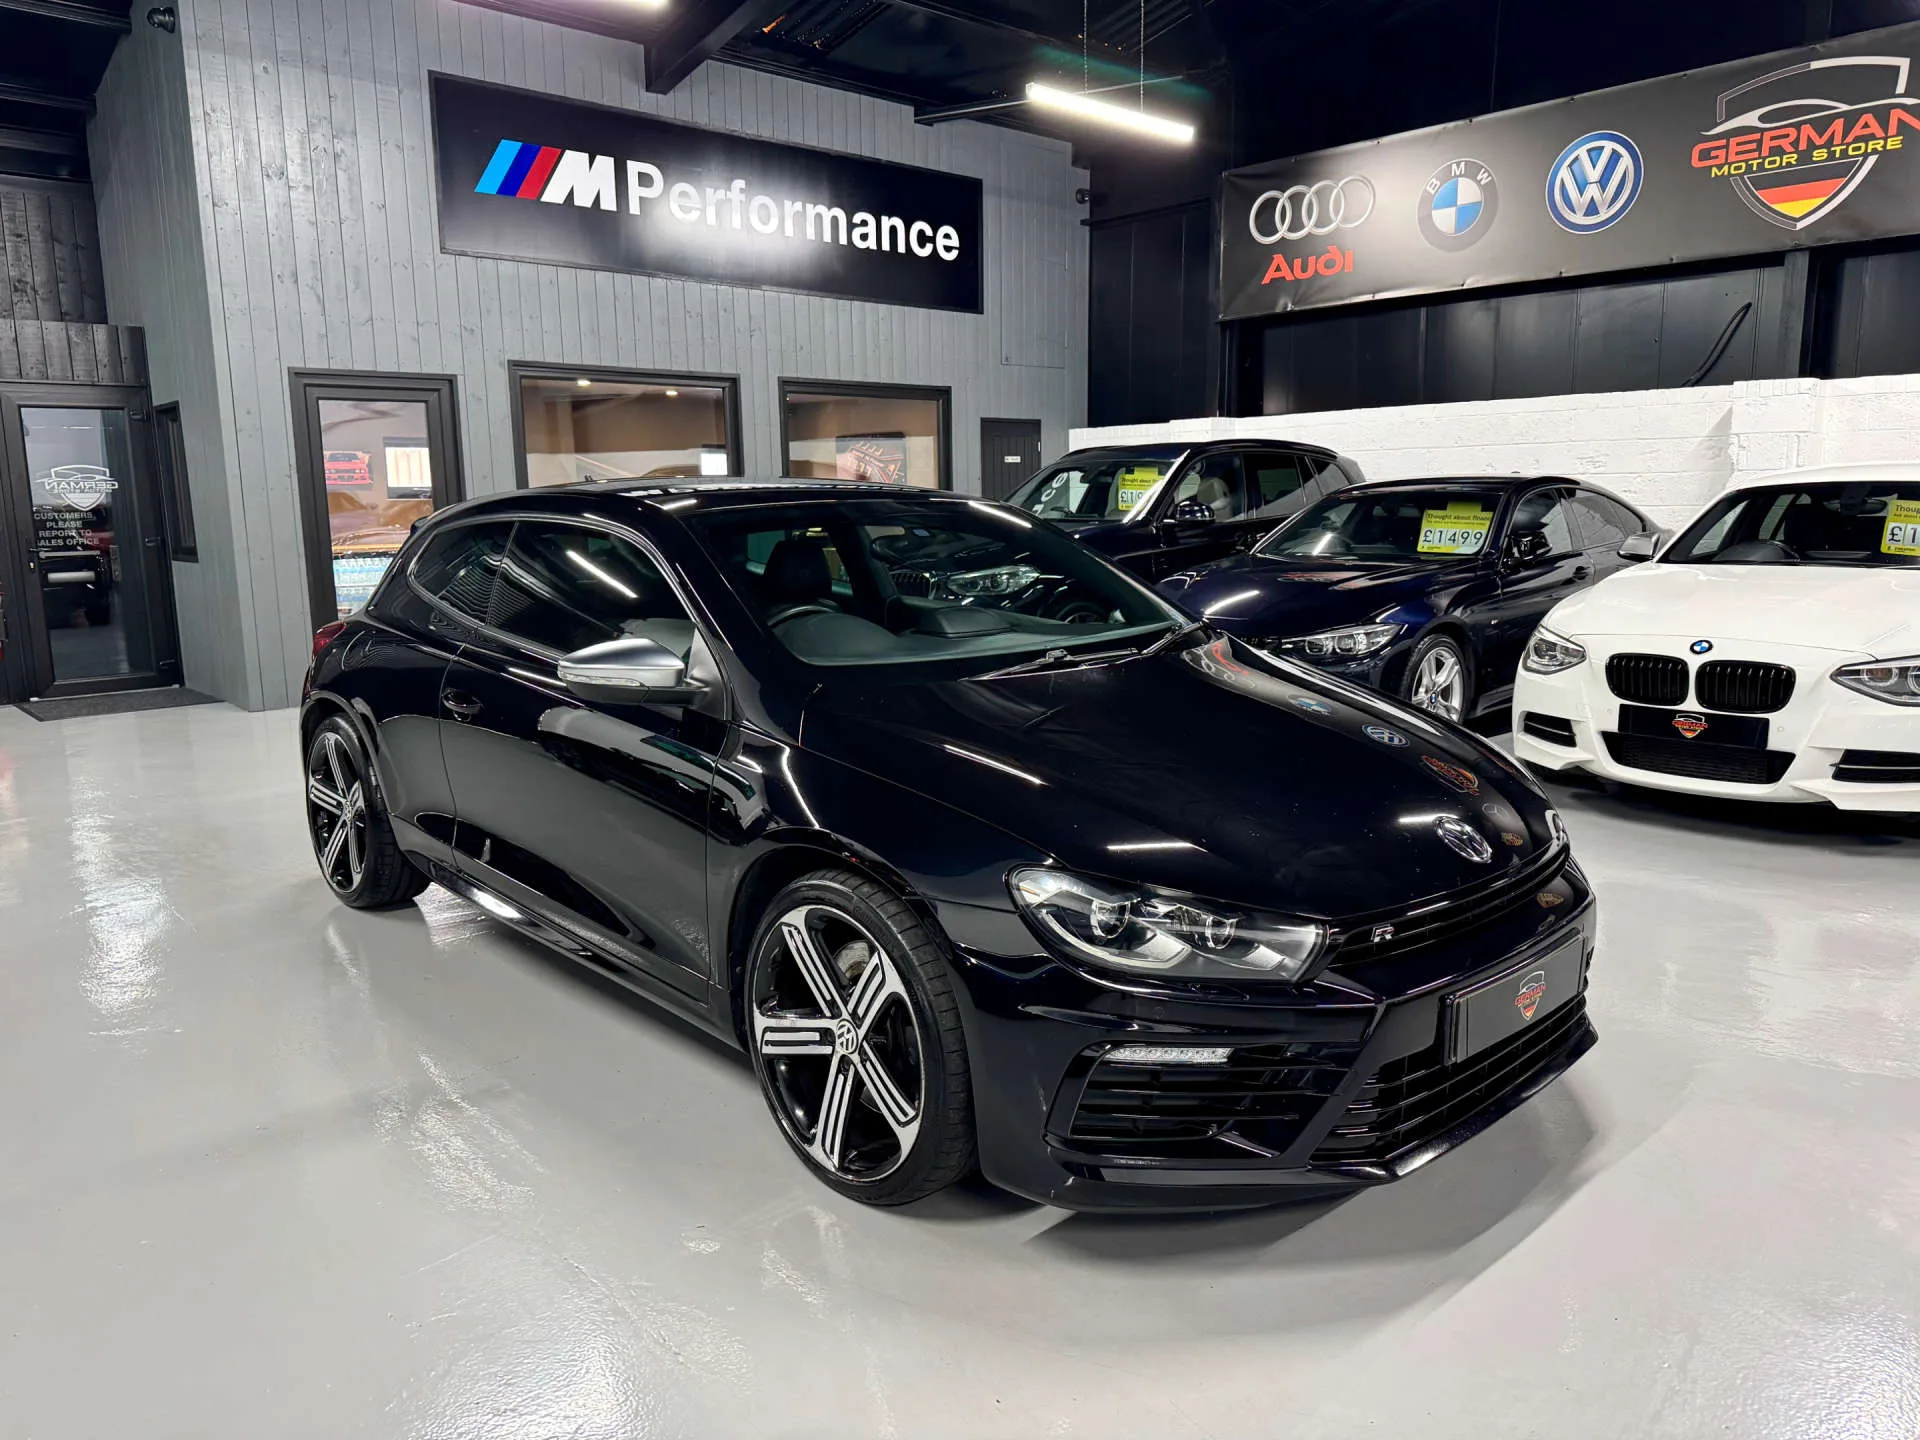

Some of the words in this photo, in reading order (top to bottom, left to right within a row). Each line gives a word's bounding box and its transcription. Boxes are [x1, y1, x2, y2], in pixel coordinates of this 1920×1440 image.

[1690, 108, 1920, 169] GERMAN
[1710, 153, 1799, 178] MOTOR
[1811, 136, 1904, 162] STORE
[1424, 160, 1493, 195] BMW
[540, 149, 617, 212] M
[626, 159, 961, 262] Performance
[1261, 246, 1355, 285] Audi
[34, 511, 93, 520] CUSTOMERS
[46, 520, 83, 529] PLEASE
[40, 530, 77, 538] REPORT
[65, 537, 100, 546] OFFICE
[1422, 529, 1484, 545] £1499
